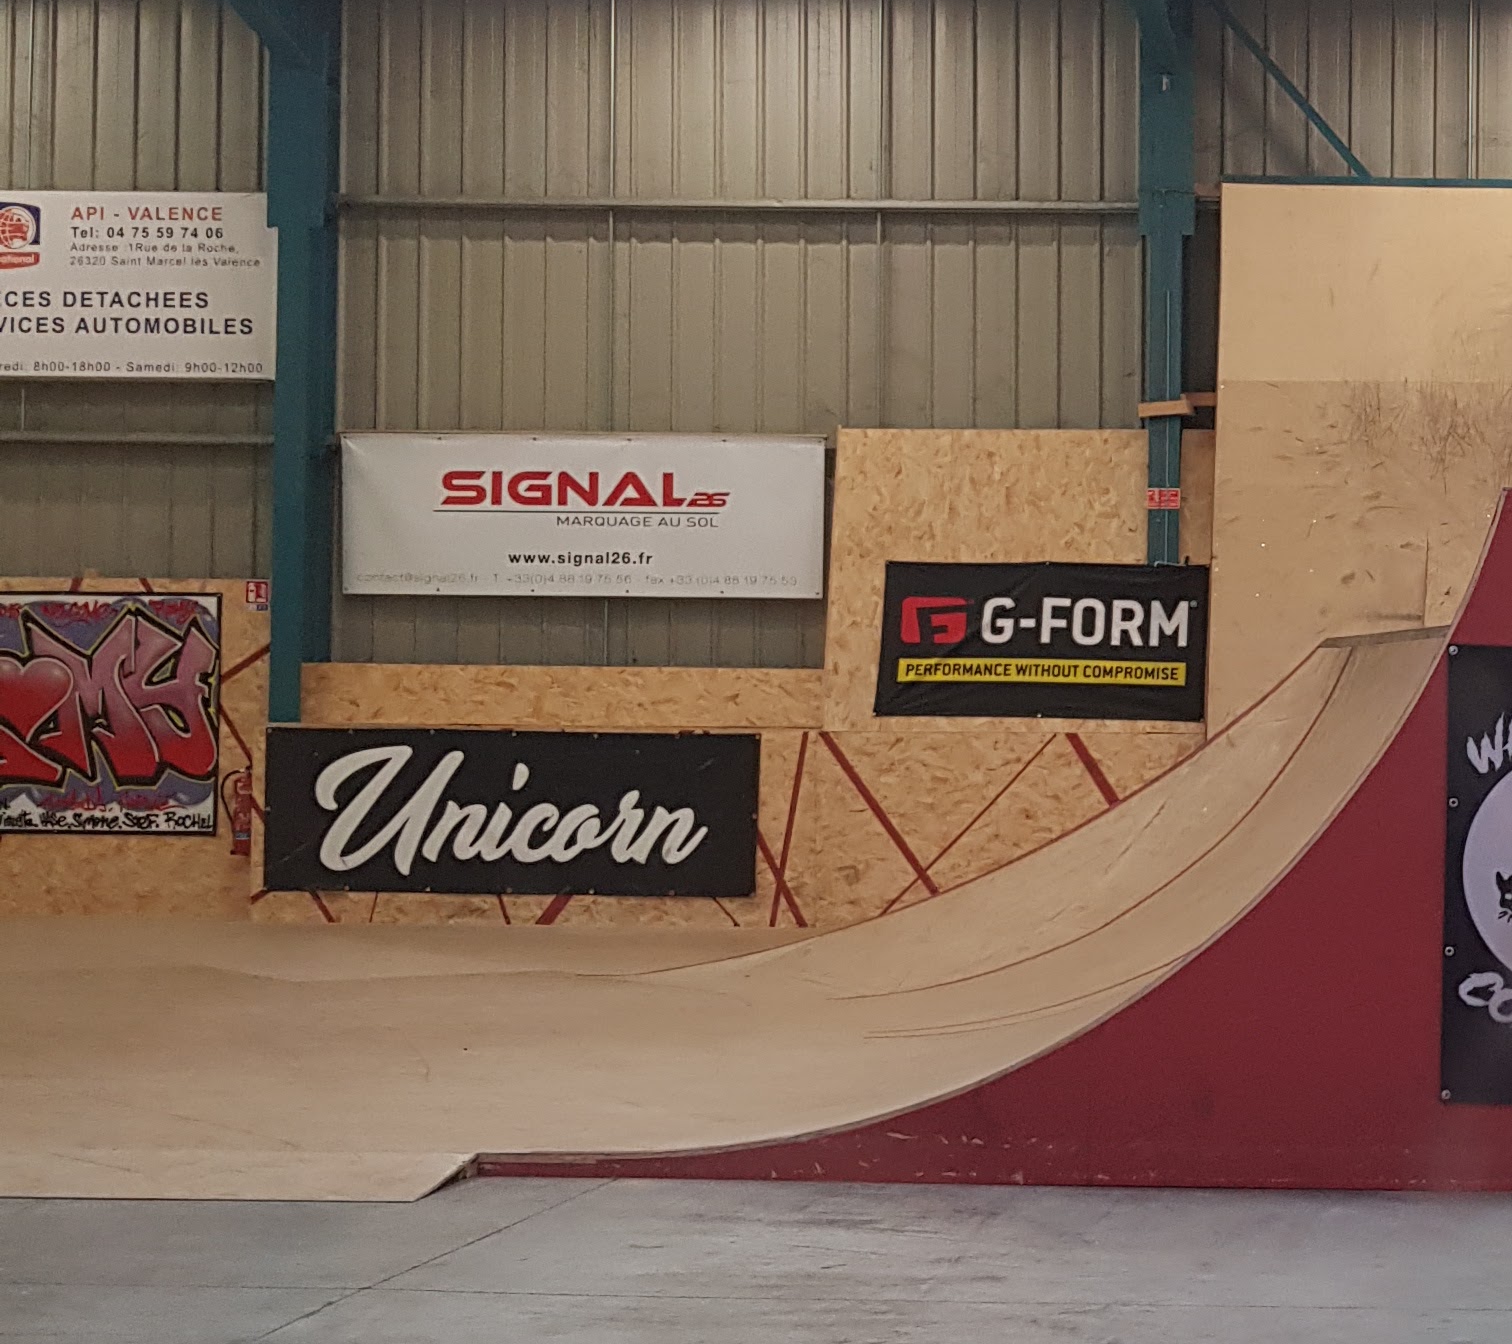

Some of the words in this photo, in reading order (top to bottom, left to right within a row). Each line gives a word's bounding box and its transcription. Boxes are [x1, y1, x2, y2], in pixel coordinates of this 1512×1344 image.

[71, 206, 105, 221] API
[127, 207, 224, 222] VALENCE
[71, 226, 99, 239] Tel:
[106, 226, 125, 239] 04
[131, 226, 150, 239] 75
[156, 226, 174, 239] 59
[180, 227, 199, 239] 74
[205, 227, 224, 239] 06
[111, 257, 141, 267] Saint
[146, 257, 186, 267] Marcel
[213, 258, 261, 268] Valence
[0, 291, 52, 308] CES
[62, 291, 210, 309] DETACHEES
[74, 317, 254, 335] AUTOMOBILES
[32, 361, 111, 373] 8h00-18h00
[184, 362, 263, 374] 9h00-12h00
[556, 515, 653, 528] MARQUAGE
[658, 517, 681, 529] AU
[686, 517, 719, 529] SOL
[507, 551, 654, 567] www.signal26.fr
[905, 663, 1012, 679] PERFORMANCE
[1015, 664, 1080, 679] WITHOUT
[1082, 665, 1180, 681] COMPROMISE
[314, 744, 709, 877] Unicorn
